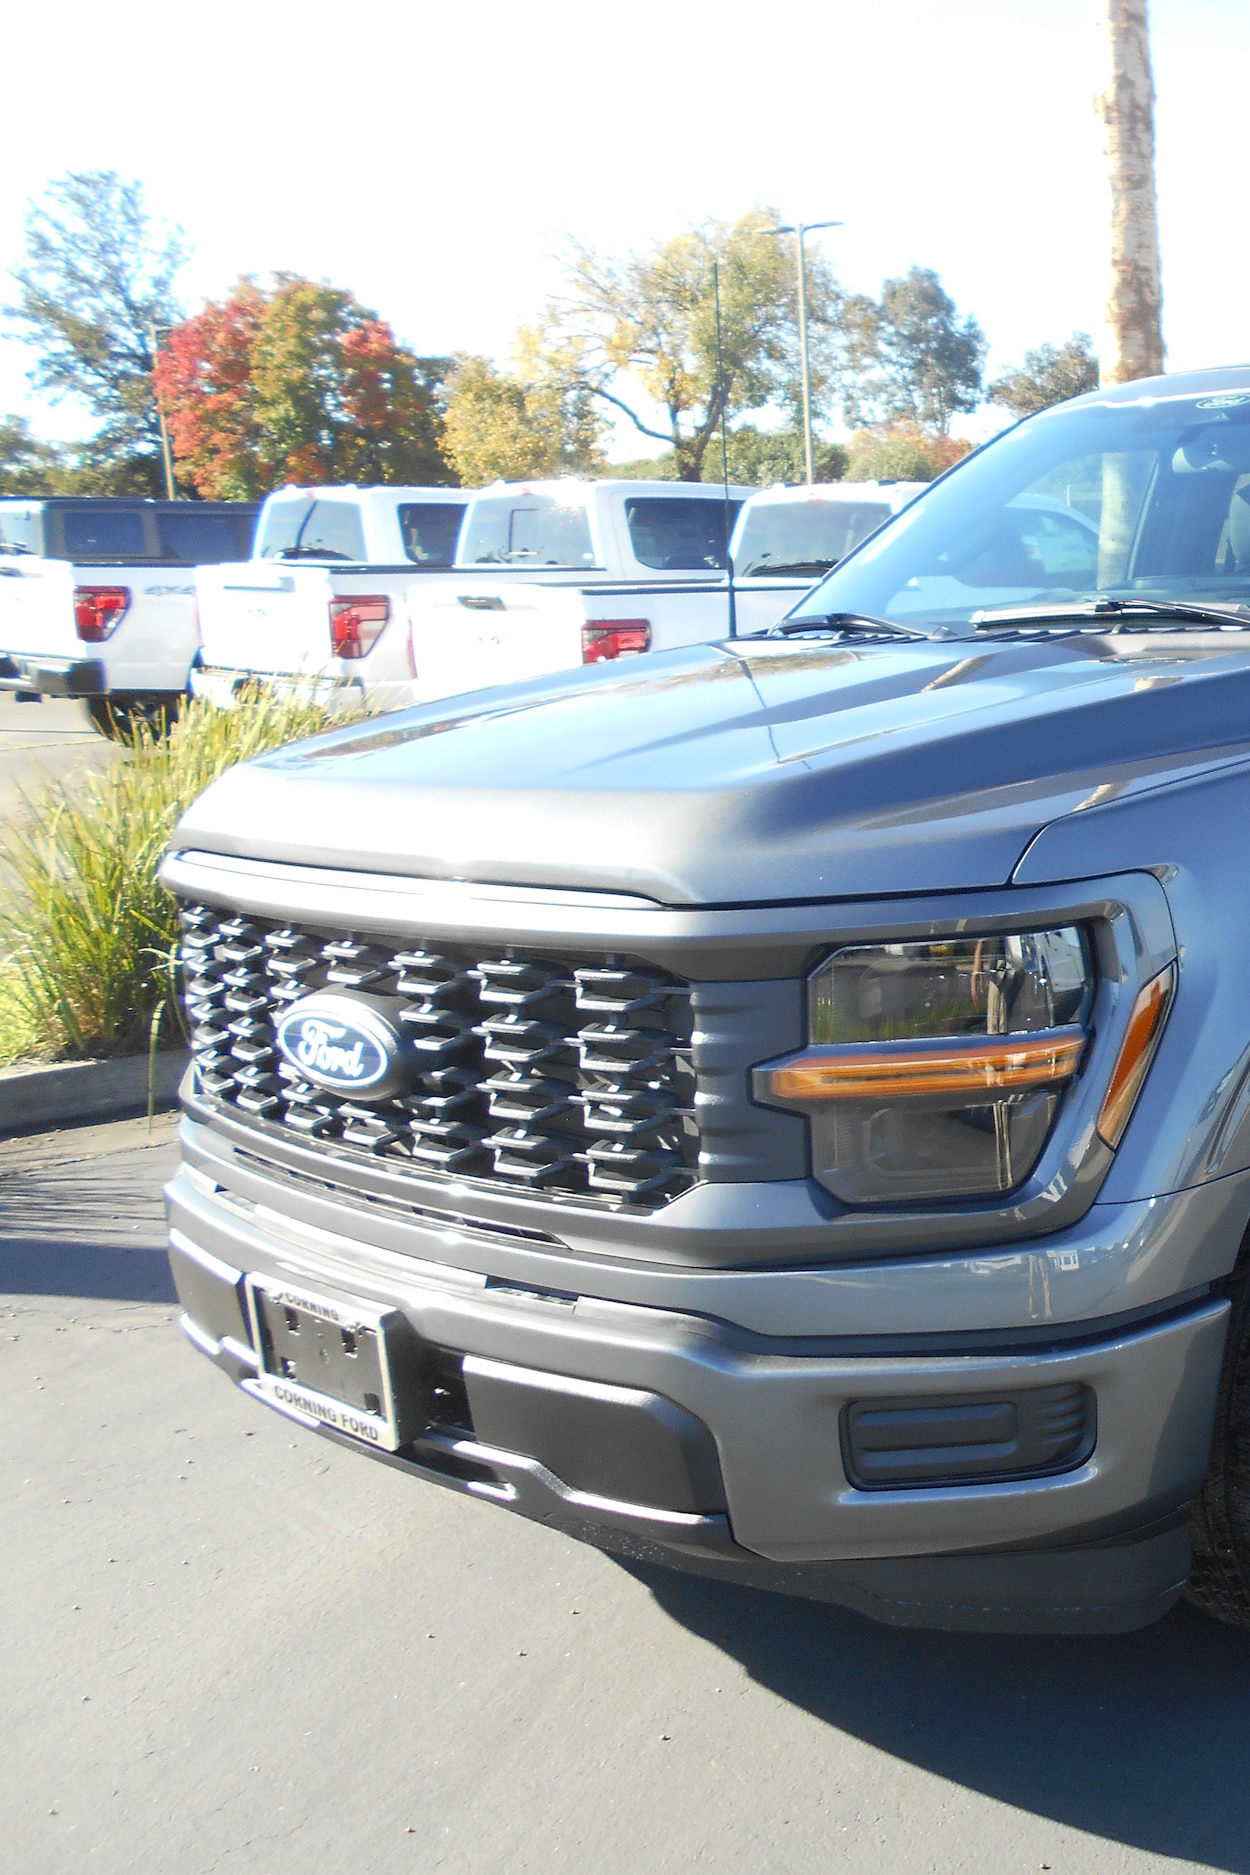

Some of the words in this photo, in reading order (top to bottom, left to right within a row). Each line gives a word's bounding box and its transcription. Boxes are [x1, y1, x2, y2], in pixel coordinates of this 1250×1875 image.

[297, 1018, 365, 1078] Ford
[283, 1292, 340, 1321] CORNING
[273, 1384, 338, 1424] CORNING
[340, 1412, 379, 1441] FORD
